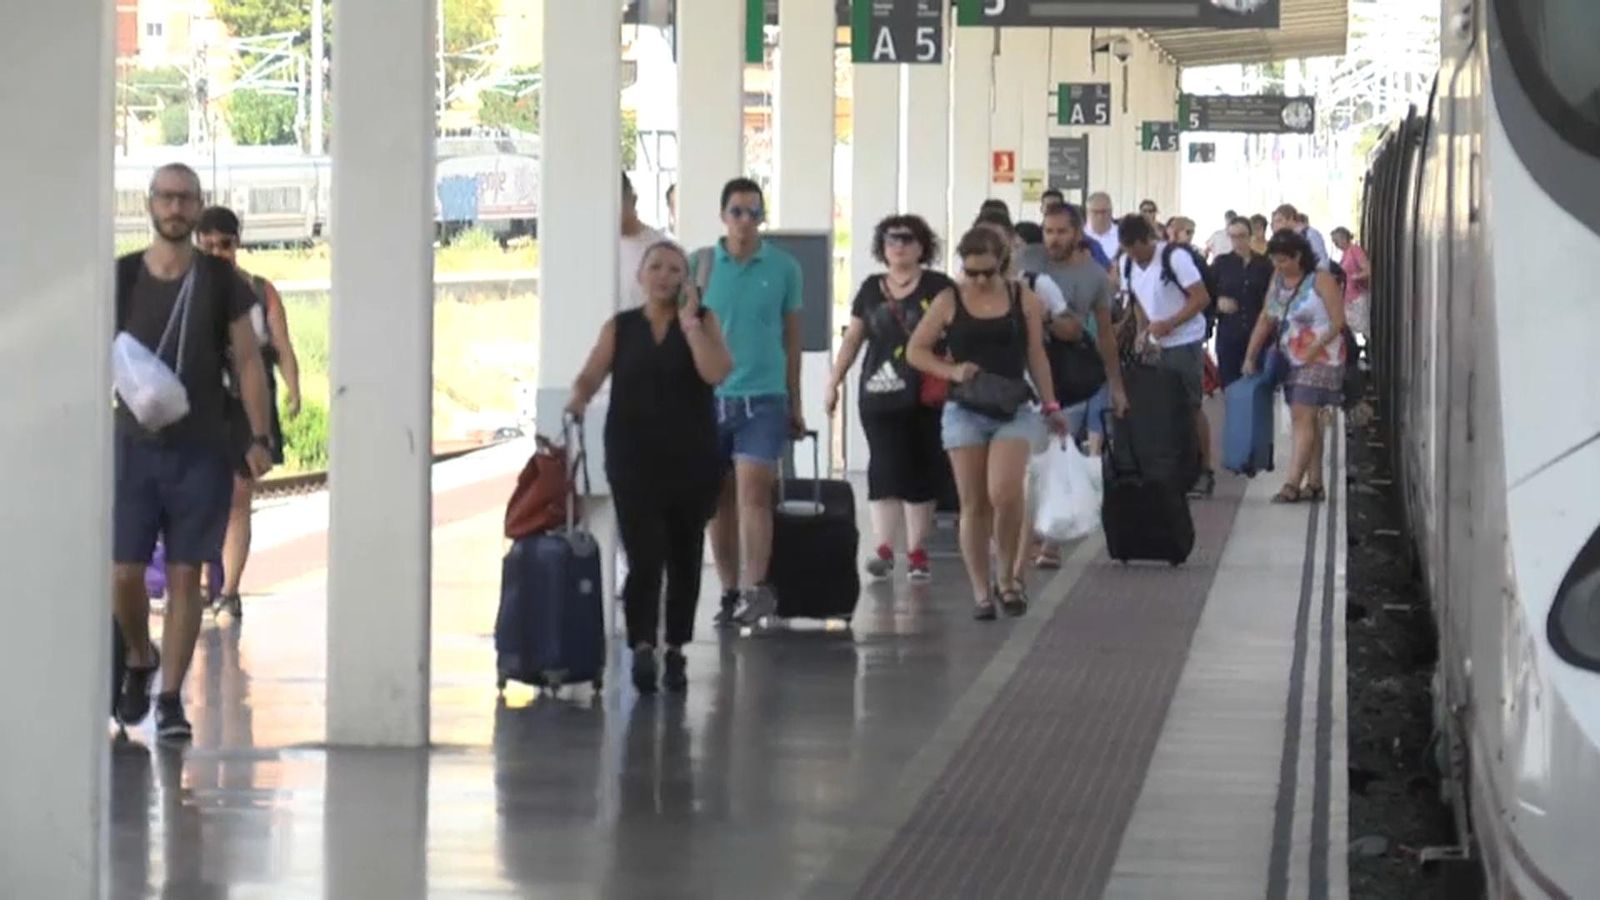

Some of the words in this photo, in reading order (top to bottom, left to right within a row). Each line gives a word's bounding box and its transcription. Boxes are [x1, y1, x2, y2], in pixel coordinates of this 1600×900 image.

[873, 26, 897, 60] A
[916, 26, 936, 61] 5
[1070, 103, 1085, 123] A
[1095, 103, 1107, 123] 5
[1189, 113, 1200, 129] 5
[1150, 135, 1161, 150] A
